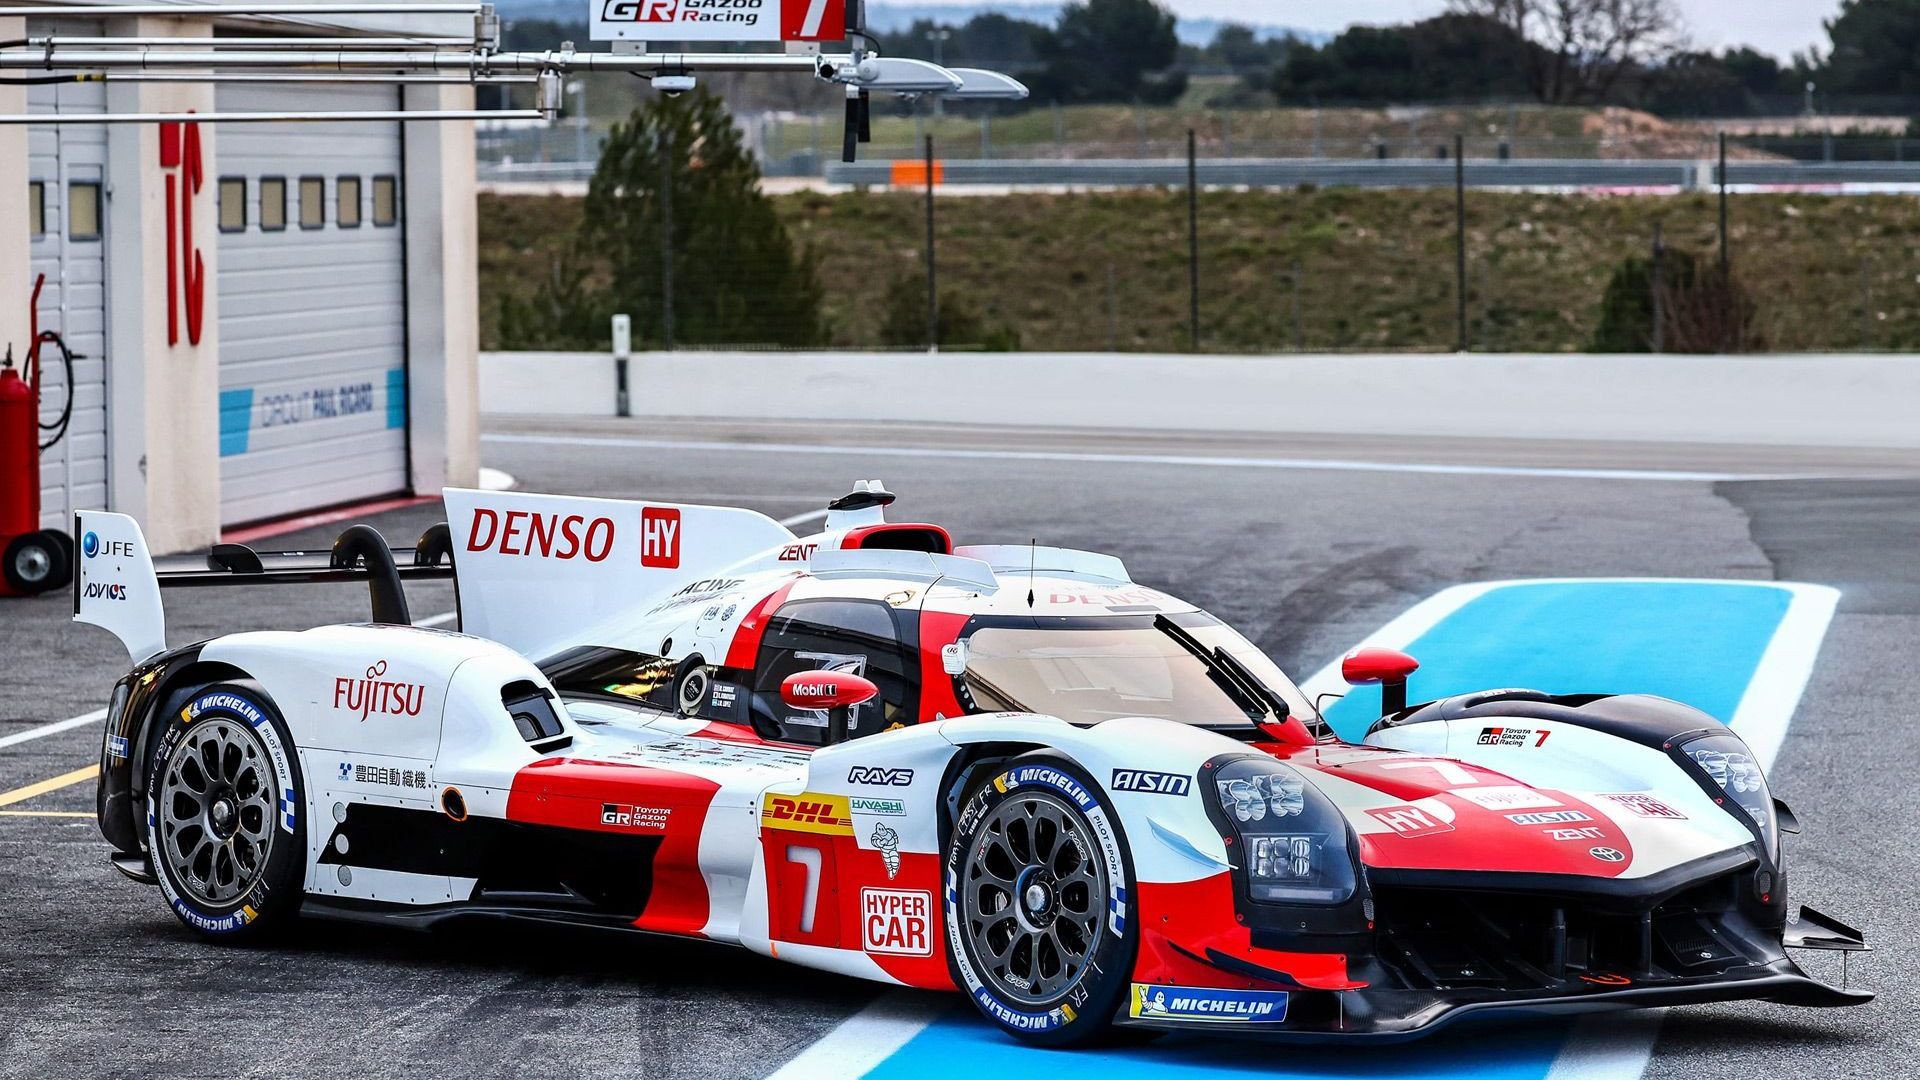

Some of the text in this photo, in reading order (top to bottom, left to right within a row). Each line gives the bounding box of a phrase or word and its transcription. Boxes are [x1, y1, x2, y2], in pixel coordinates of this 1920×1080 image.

[682, 11, 758, 25] Racing
[466, 508, 615, 562] DENSO
[643, 519, 678, 558] HY
[101, 541, 134, 557] JFE
[778, 544, 818, 561] ZENT
[334, 677, 425, 722] FUJITSU
[792, 683, 824, 696] Mobil
[201, 695, 261, 723] MICHELIN
[1478, 734, 1499, 745] GR
[1535, 730, 1551, 747] 7
[262, 728, 286, 780] PILOT SPORT
[848, 766, 914, 786] RAYS
[1113, 771, 1190, 795] AISIN
[1378, 761, 1479, 785] 7
[1020, 768, 1091, 806] MICHELIN
[635, 806, 672, 815] TOYOTA
[772, 798, 839, 826] DHL
[852, 800, 903, 811] HAYASHI
[1622, 802, 1680, 818] CAR
[603, 812, 630, 824] GR
[633, 820, 666, 829] Racing
[634, 813, 667, 821] GAZOO
[1374, 809, 1436, 832] HY
[1513, 811, 1588, 824] AISIN
[1543, 827, 1606, 841] ZENT
[1093, 815, 1118, 877] PILOT SPORT
[786, 844, 822, 934] 7
[177, 903, 233, 930] MICHELIN
[866, 895, 926, 917] HYPER
[868, 916, 926, 949] CAR
[960, 959, 974, 984] PILOT
[980, 992, 1048, 1029] MICHELIN
[1170, 997, 1274, 1014] MICHELIN
